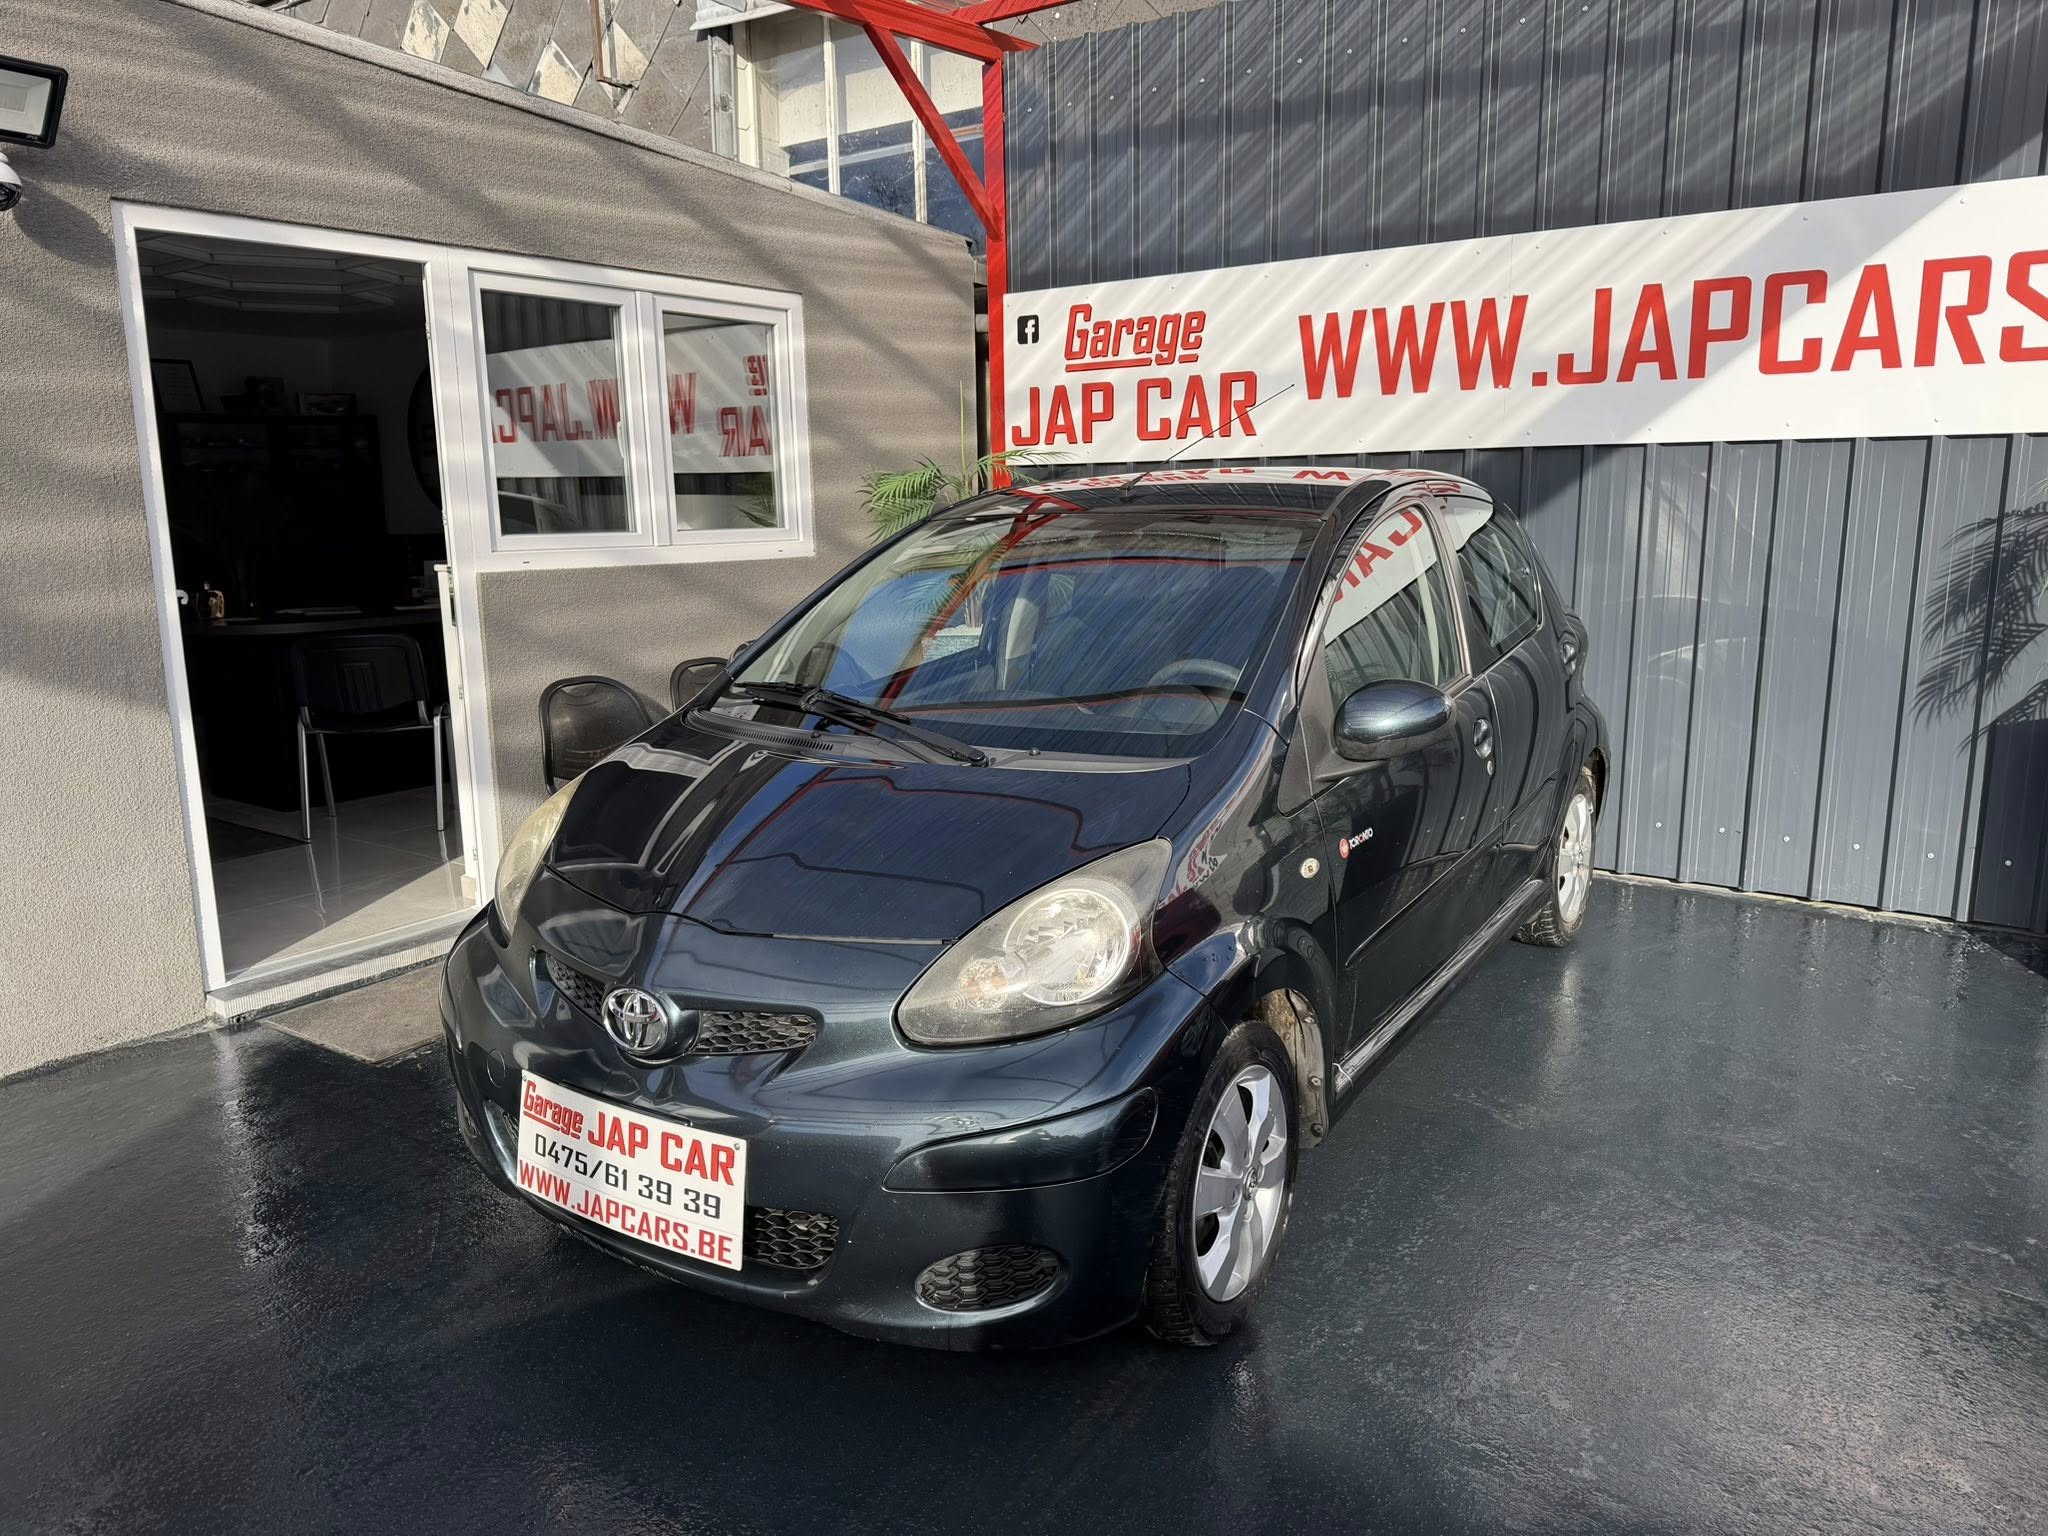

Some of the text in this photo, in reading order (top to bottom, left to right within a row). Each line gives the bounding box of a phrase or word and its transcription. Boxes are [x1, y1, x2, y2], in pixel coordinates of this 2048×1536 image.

[1064, 303, 1206, 366] Garage
[1011, 371, 1257, 446] JAP CAR
[523, 1080, 735, 1186] Garage JAP CAR
[535, 1133, 721, 1219] 0475/61 39 39
[519, 1159, 733, 1265] WWW.JAPCARS.BE
